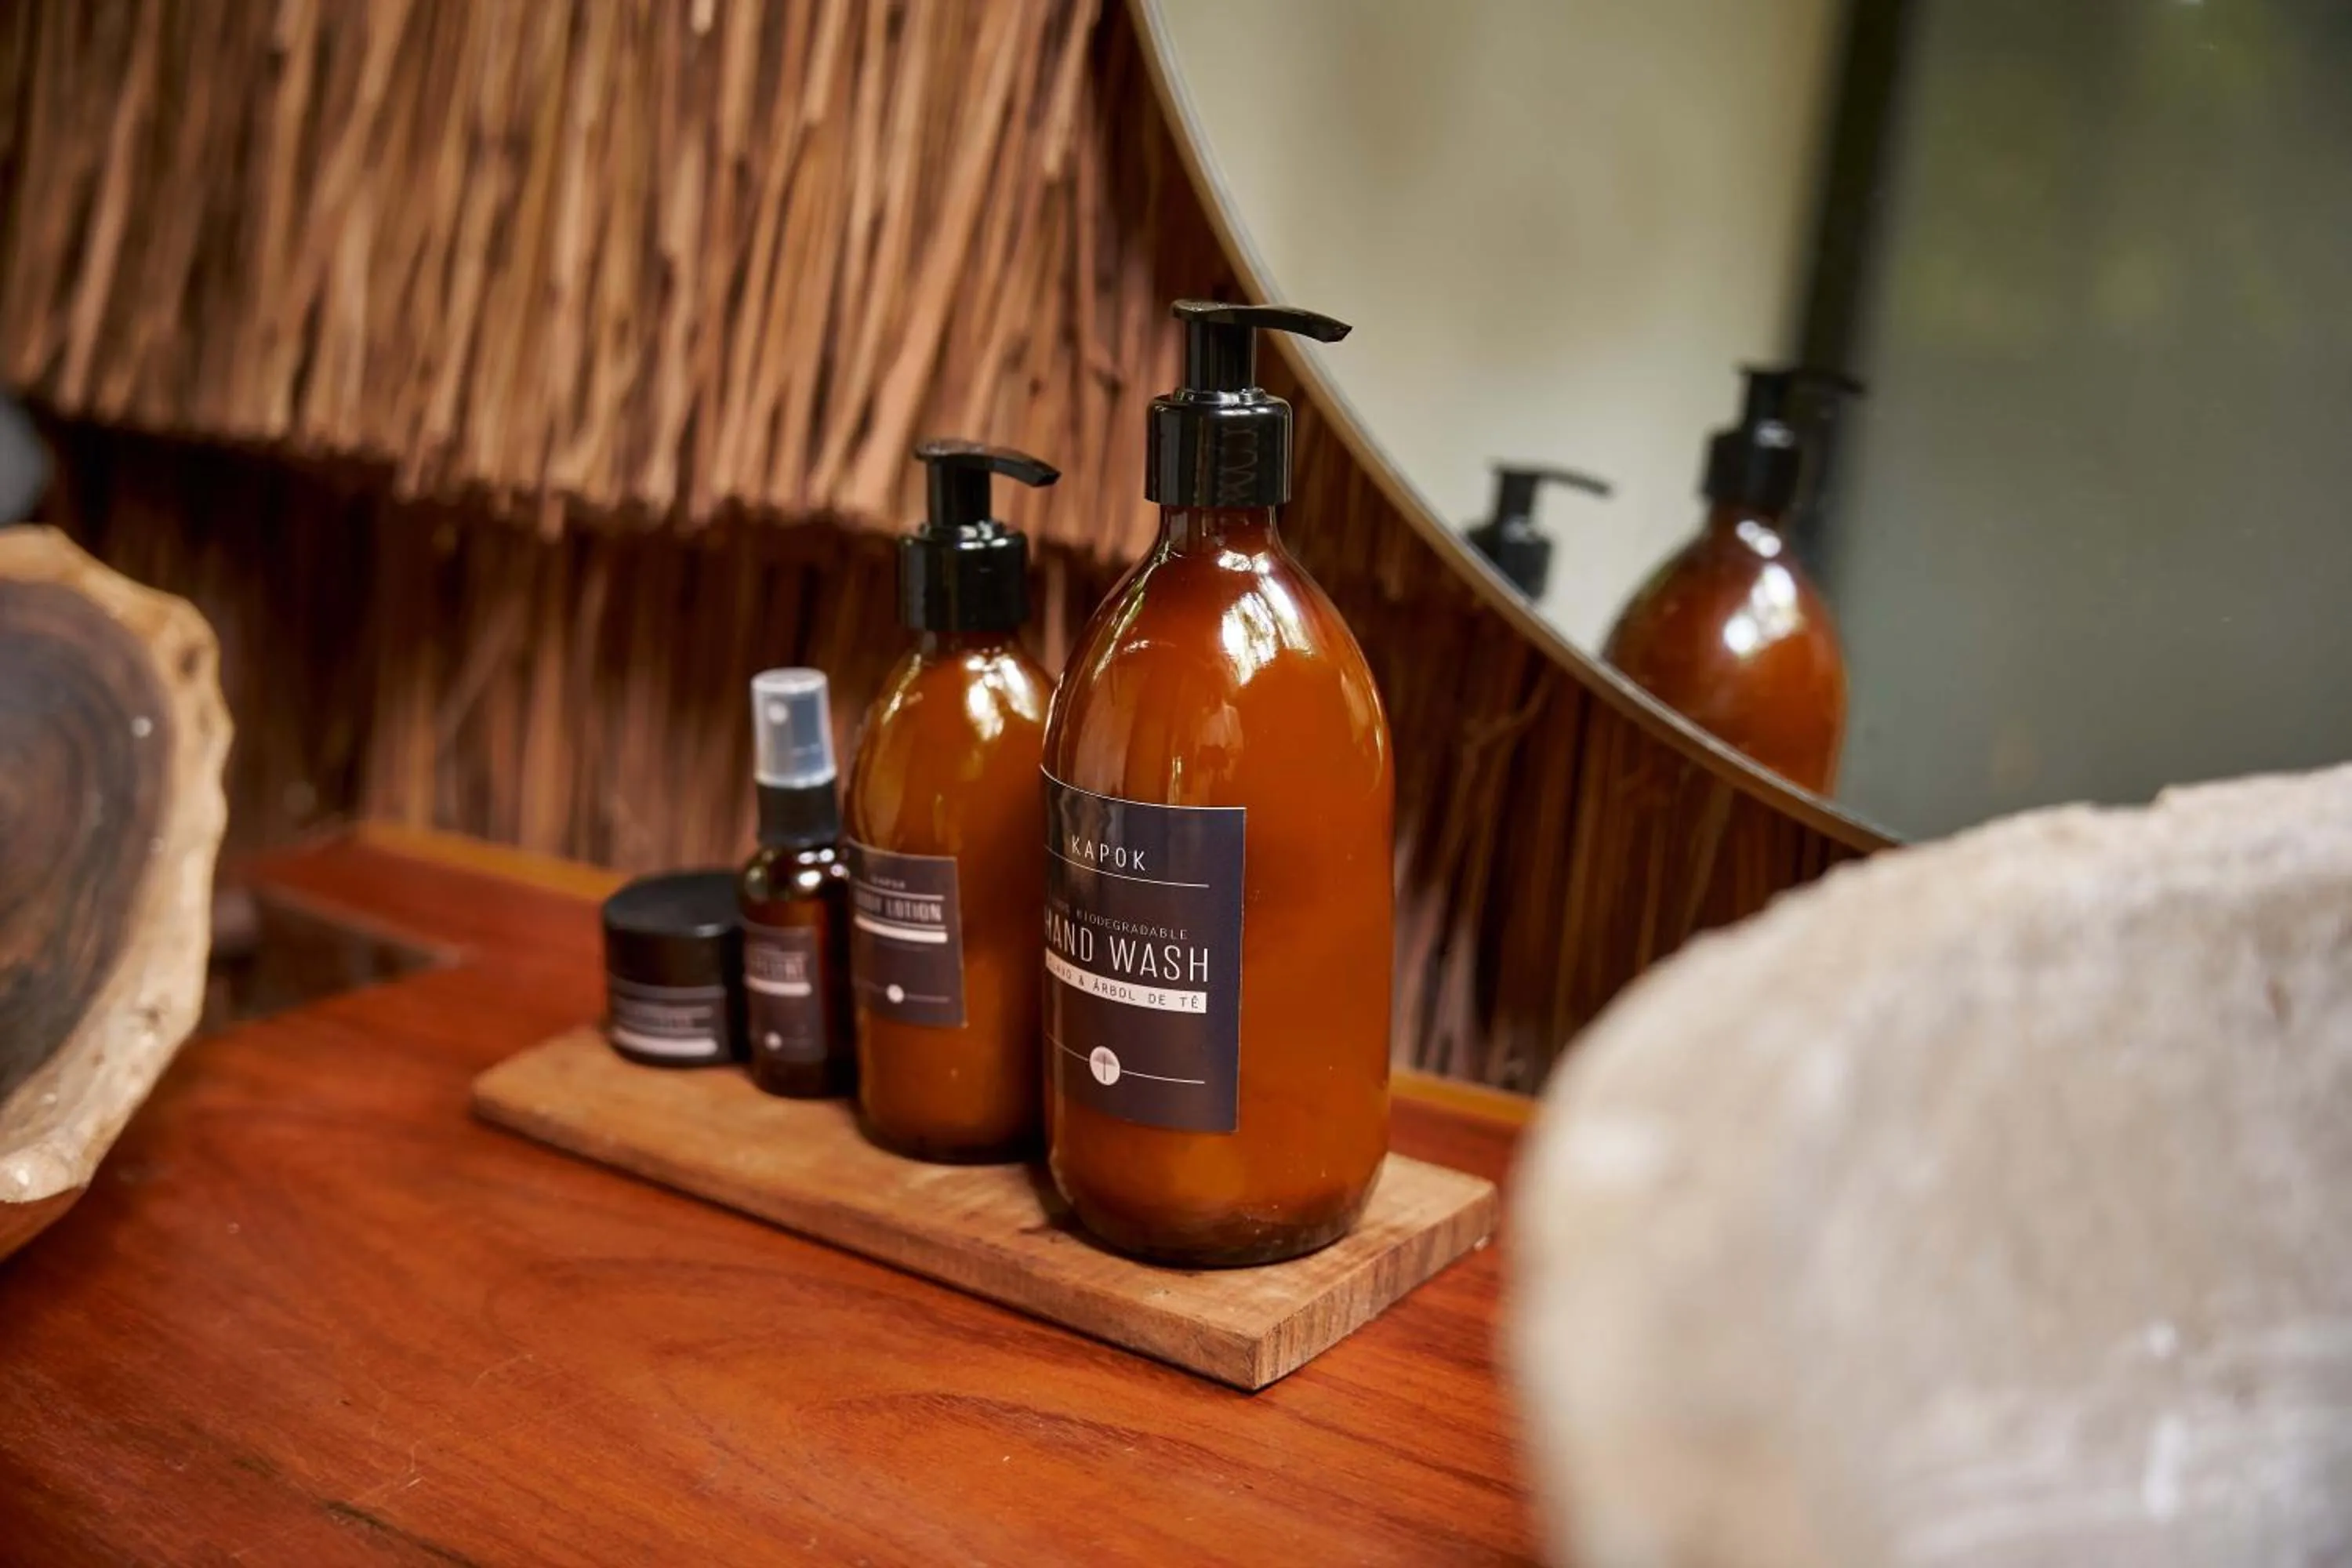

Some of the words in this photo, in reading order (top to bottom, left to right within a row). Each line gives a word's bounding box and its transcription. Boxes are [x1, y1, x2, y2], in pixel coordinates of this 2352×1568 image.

[1072, 834, 1145, 871] KAPOK
[1076, 908, 1188, 940] BIODEGRADABLE
[1044, 906, 1093, 962] HAND
[1109, 935, 1208, 983] WASH
[1092, 978, 1136, 1001] ÁRBOL
[1148, 993, 1166, 1007] DE
